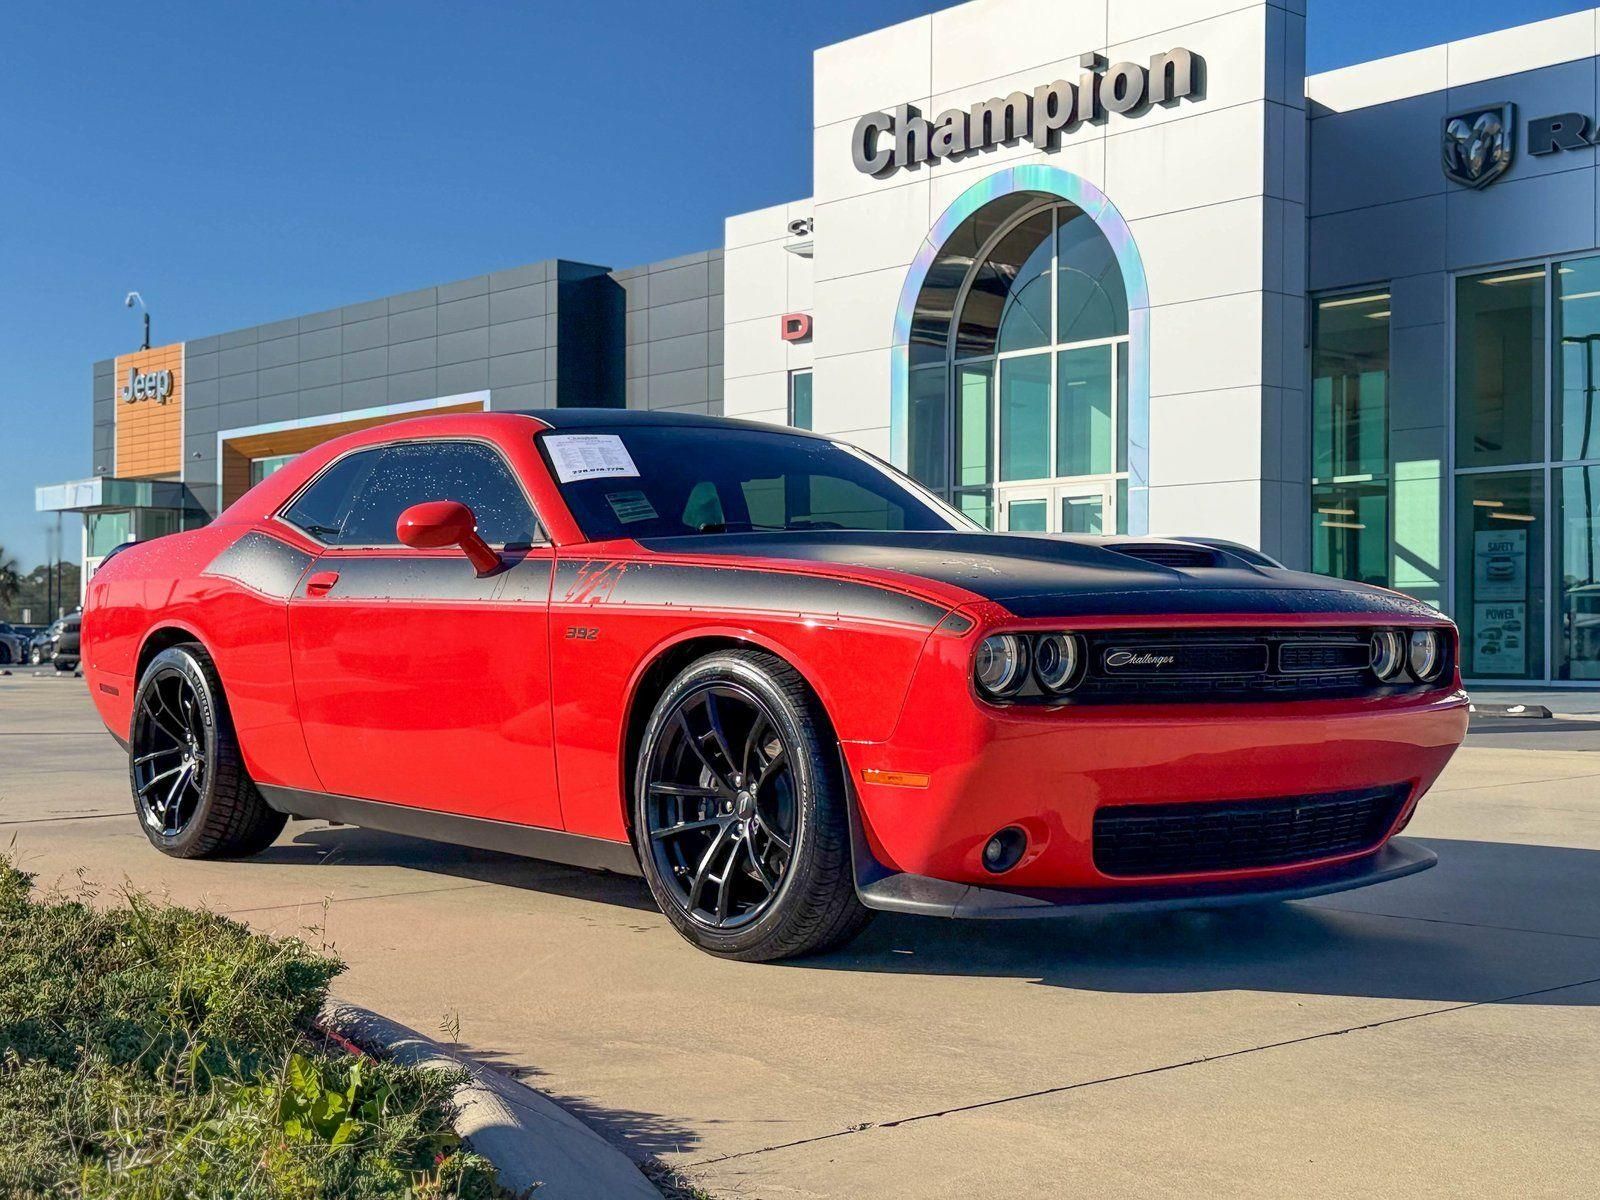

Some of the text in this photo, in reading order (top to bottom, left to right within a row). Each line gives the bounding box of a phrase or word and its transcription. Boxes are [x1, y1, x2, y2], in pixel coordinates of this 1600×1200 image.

[851, 47, 1207, 180] Champion
[121, 366, 174, 405] Jeep
[1487, 541, 1515, 552] SAFETY
[1485, 608, 1515, 620] POWER
[565, 627, 600, 640] 392
[1106, 651, 1174, 668] Challenger
